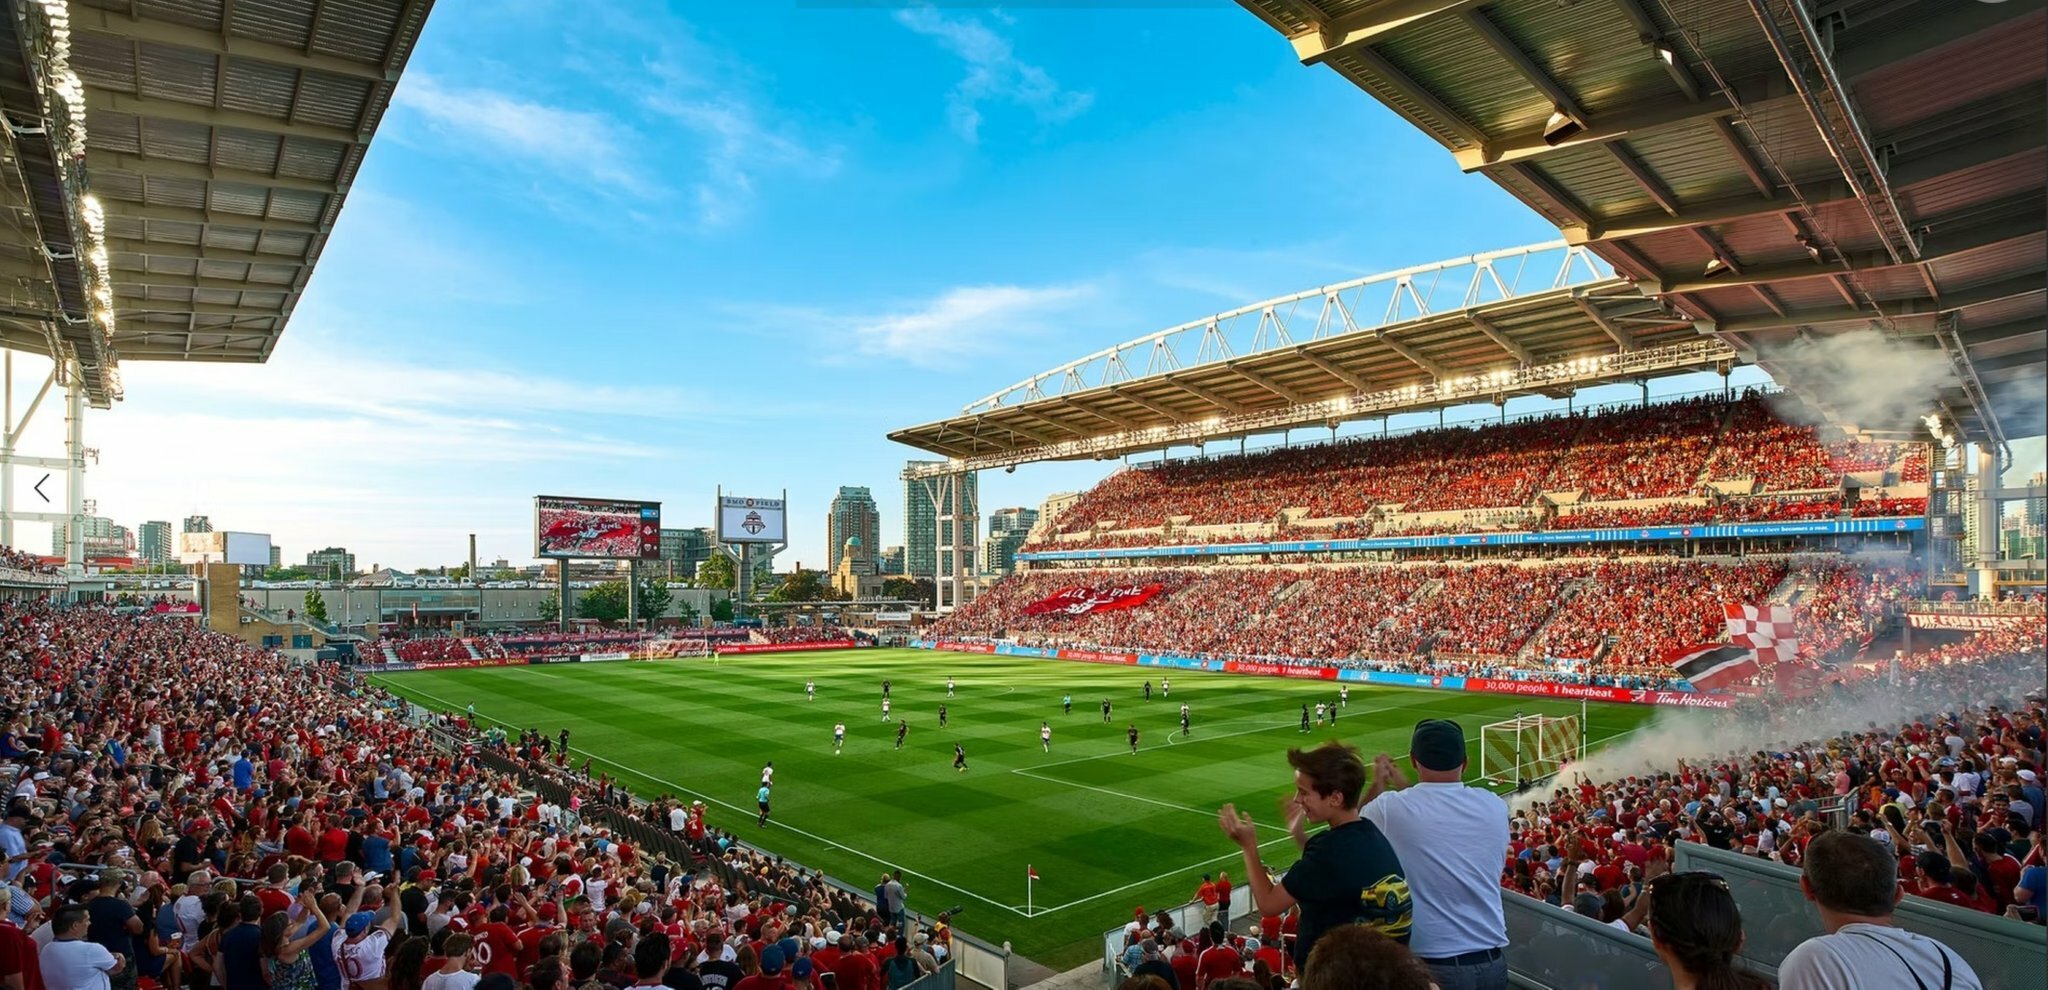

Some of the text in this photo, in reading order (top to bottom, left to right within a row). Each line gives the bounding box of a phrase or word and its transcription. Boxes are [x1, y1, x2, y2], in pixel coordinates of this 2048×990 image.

[1909, 614, 1937, 628] THE
[1287, 667, 1322, 676] heartbeat.
[1485, 681, 1515, 691] 30,000
[1516, 683, 1550, 693] people.
[1561, 686, 1616, 698] heartbeat.
[1656, 692, 1678, 704] Tim
[1679, 692, 1728, 708] Hortons
